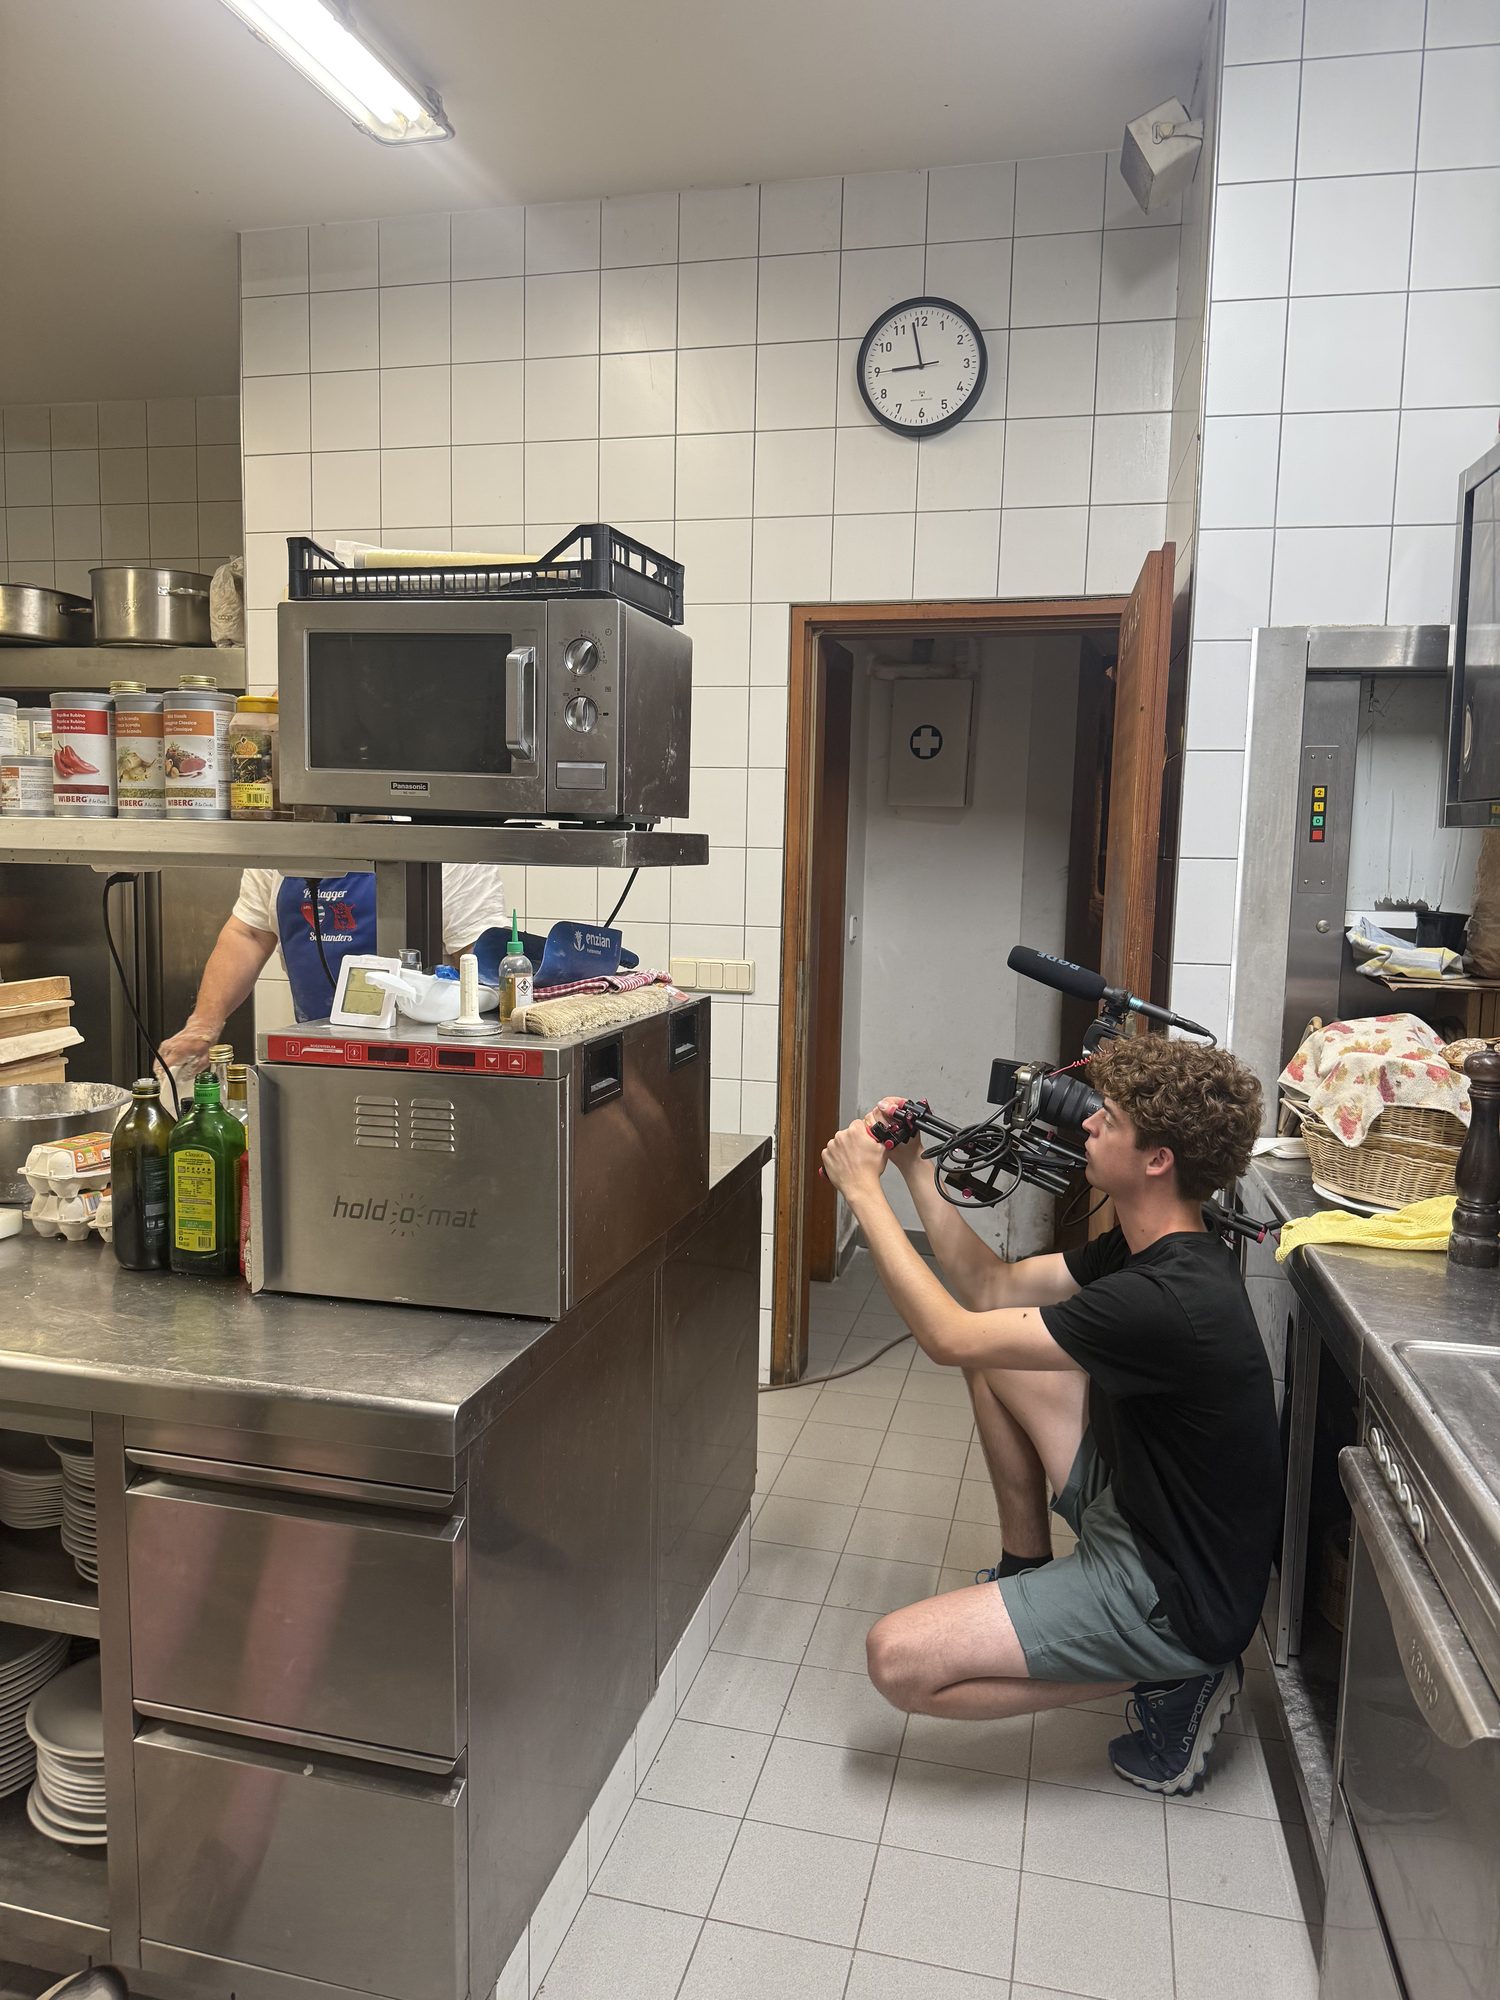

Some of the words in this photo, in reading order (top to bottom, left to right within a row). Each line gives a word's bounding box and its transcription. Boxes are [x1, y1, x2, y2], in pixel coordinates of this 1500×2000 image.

[914, 316, 928, 327] 12
[939, 320, 945, 331] 1
[893, 324, 906, 336] 11
[956, 334, 964, 345] 2
[879, 341, 892, 353] 10
[963, 357, 970, 369] 3
[874, 366, 881, 378] 9
[956, 381, 964, 392] 4
[880, 388, 887, 399] 8
[895, 403, 902, 414] 7
[940, 399, 948, 410] 5
[918, 407, 925, 418] 6
[58, 795, 87, 803] WIBERG
[119, 799, 143, 807] WIBERG
[168, 799, 193, 807] WIBERG
[585, 932, 611, 949] enzian
[1179, 1736, 1193, 1753] LA
[1187, 1672, 1216, 1735] SPORTIV
